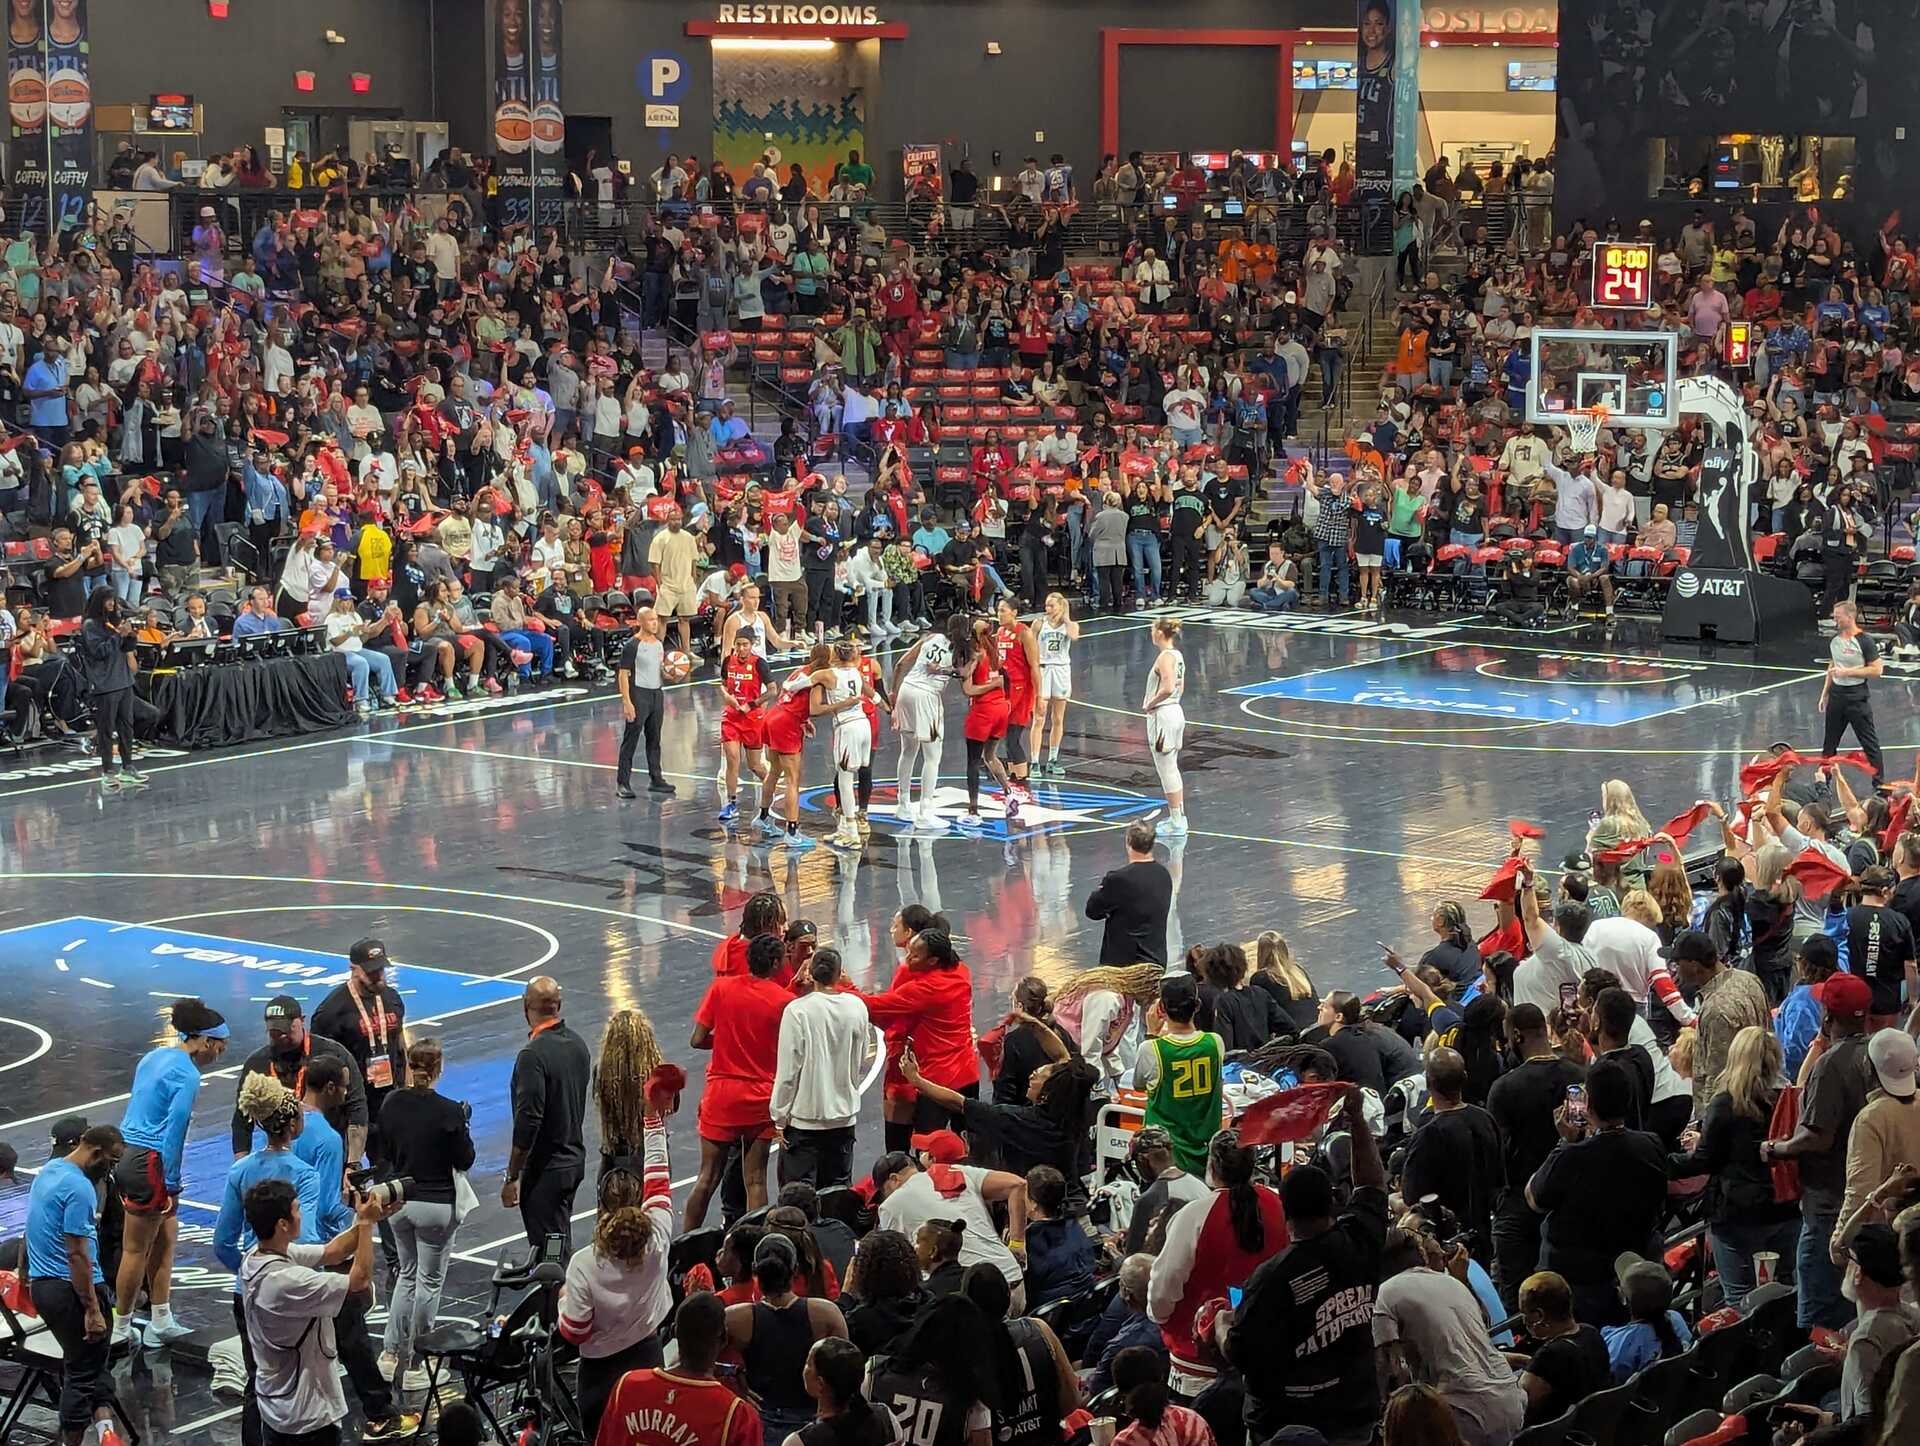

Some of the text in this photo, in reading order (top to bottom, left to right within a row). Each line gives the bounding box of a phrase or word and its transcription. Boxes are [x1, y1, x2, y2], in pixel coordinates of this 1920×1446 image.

[719, 4, 878, 25] RESTROOMS
[651, 58, 681, 97] P
[1604, 268, 1643, 301] 24
[1704, 456, 1729, 472] ally
[1701, 579, 1745, 597] AT&T
[1172, 1056, 1213, 1098] 20
[625, 1408, 701, 1446] MURRAY
[892, 1392, 944, 1446] 20
[1013, 1415, 1043, 1437] AT&T
